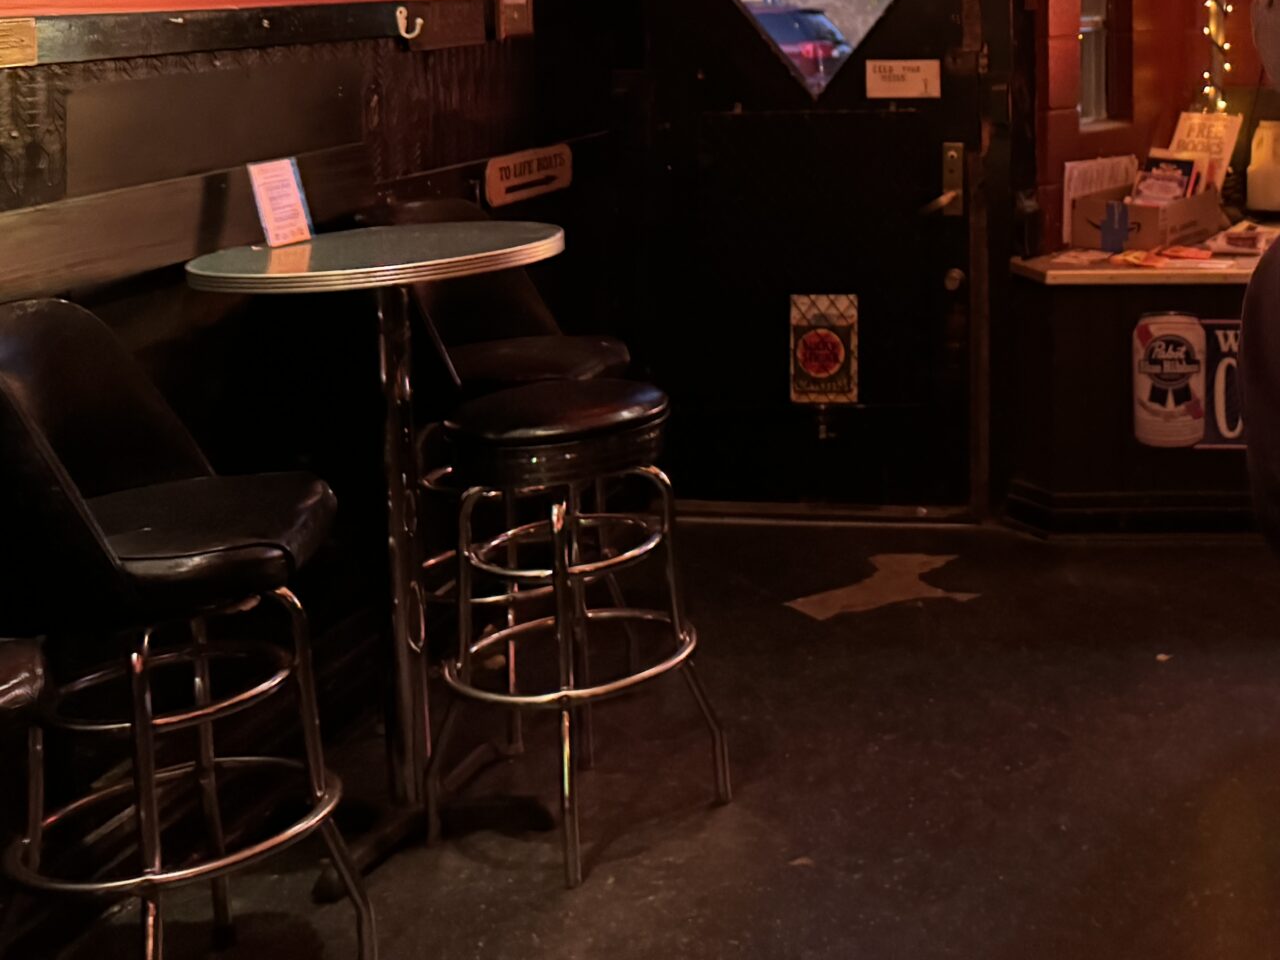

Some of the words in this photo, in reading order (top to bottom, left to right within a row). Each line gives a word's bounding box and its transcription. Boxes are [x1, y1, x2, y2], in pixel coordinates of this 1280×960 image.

[498, 166, 511, 181] TO
[513, 160, 536, 178] LIFE
[536, 152, 566, 172] BOATS
[1152, 341, 1187, 359] Pabst
